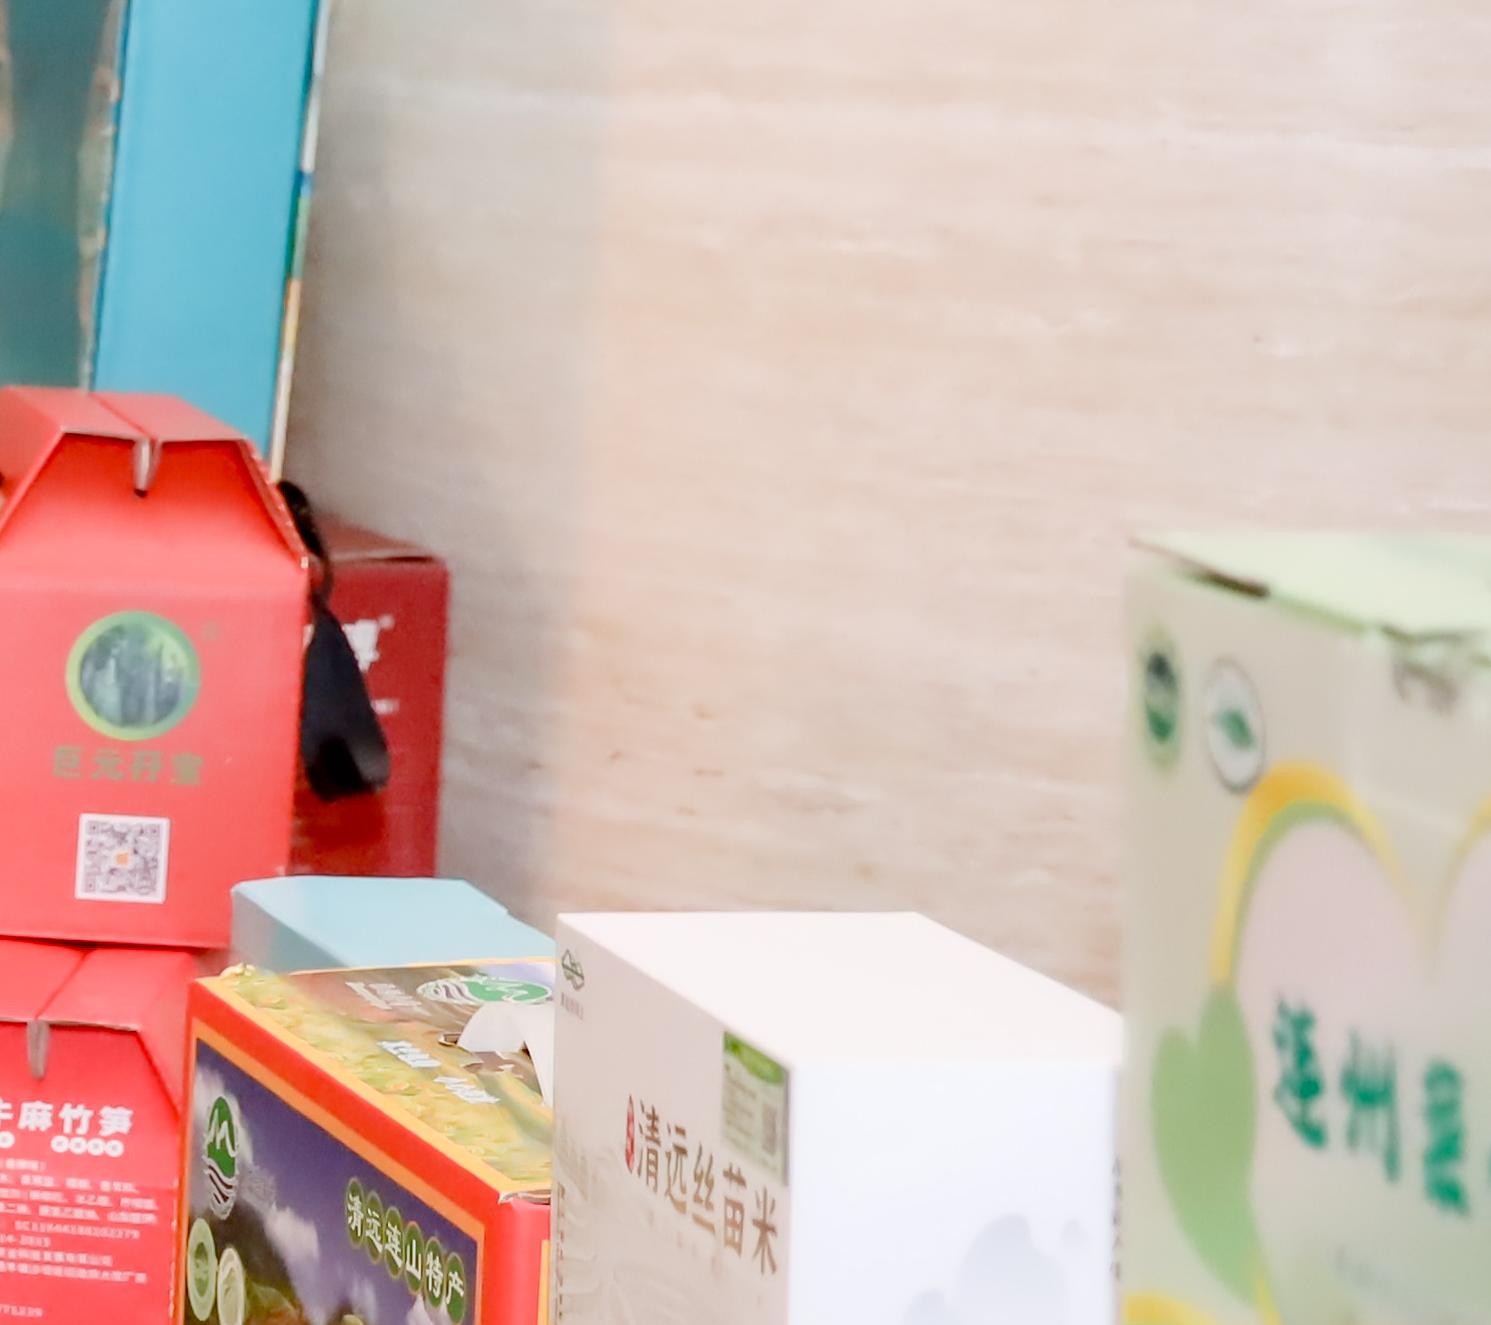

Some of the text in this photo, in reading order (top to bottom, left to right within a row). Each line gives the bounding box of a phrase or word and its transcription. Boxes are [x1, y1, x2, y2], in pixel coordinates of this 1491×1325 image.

[347, 1192, 465, 1304] 清远连山特产
[637, 1099, 778, 1276] 清远丝苗米
